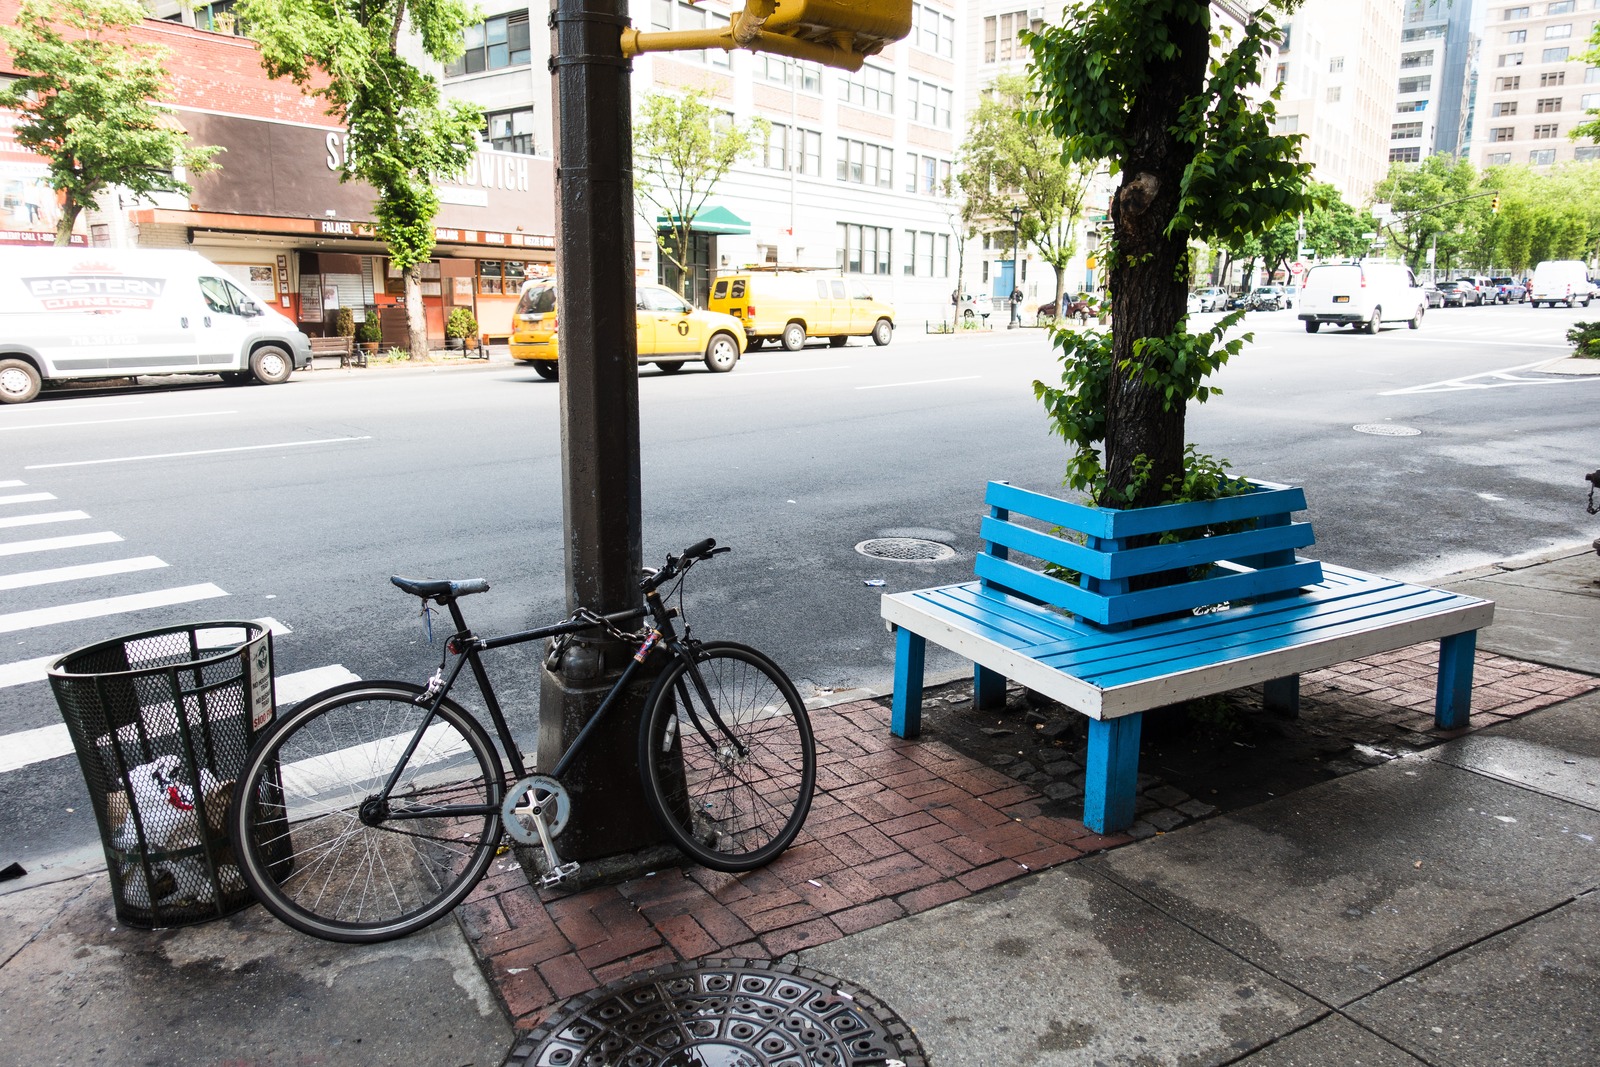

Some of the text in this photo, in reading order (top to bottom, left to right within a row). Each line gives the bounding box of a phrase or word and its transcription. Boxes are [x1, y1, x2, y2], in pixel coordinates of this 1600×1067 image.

[321, 221, 354, 234] FALAFEL
[29, 278, 161, 296] EASTERN
[45, 297, 150, 309] CUTTING CORP.
[254, 712, 267, 727] $100
